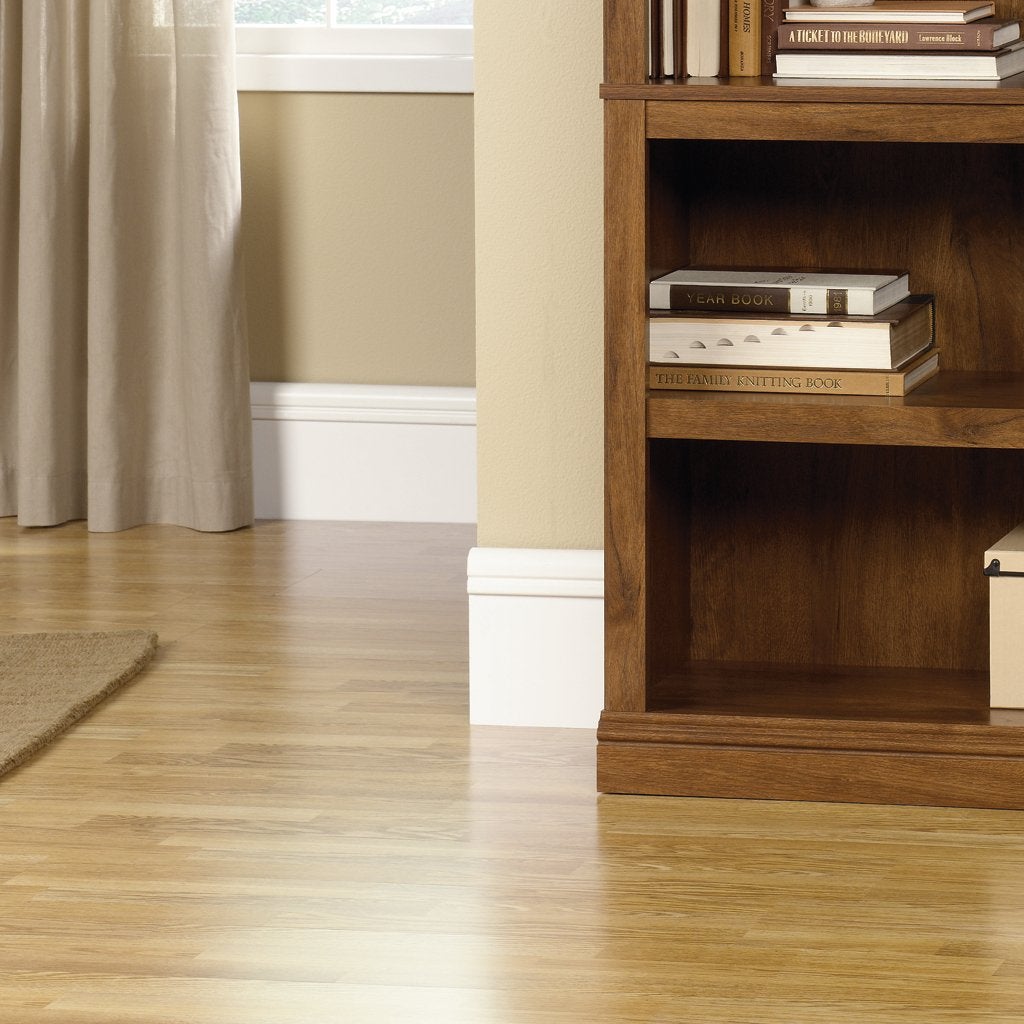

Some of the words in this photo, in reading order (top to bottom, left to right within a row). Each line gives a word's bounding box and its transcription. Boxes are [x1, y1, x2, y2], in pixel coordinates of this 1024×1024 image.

[743, 2, 751, 33] HOMES
[789, 30, 796, 43] A
[797, 29, 830, 43] TICKET
[831, 31, 841, 43] TO
[842, 31, 858, 44] THE
[919, 34, 945, 42] Lawrence
[688, 293, 725, 305] YEAR
[731, 295, 774, 306] BOOK
[656, 373, 683, 384] THE
[687, 373, 731, 386] FAMILY
[736, 375, 802, 388] KNITTING
[806, 377, 843, 389] BOOK
